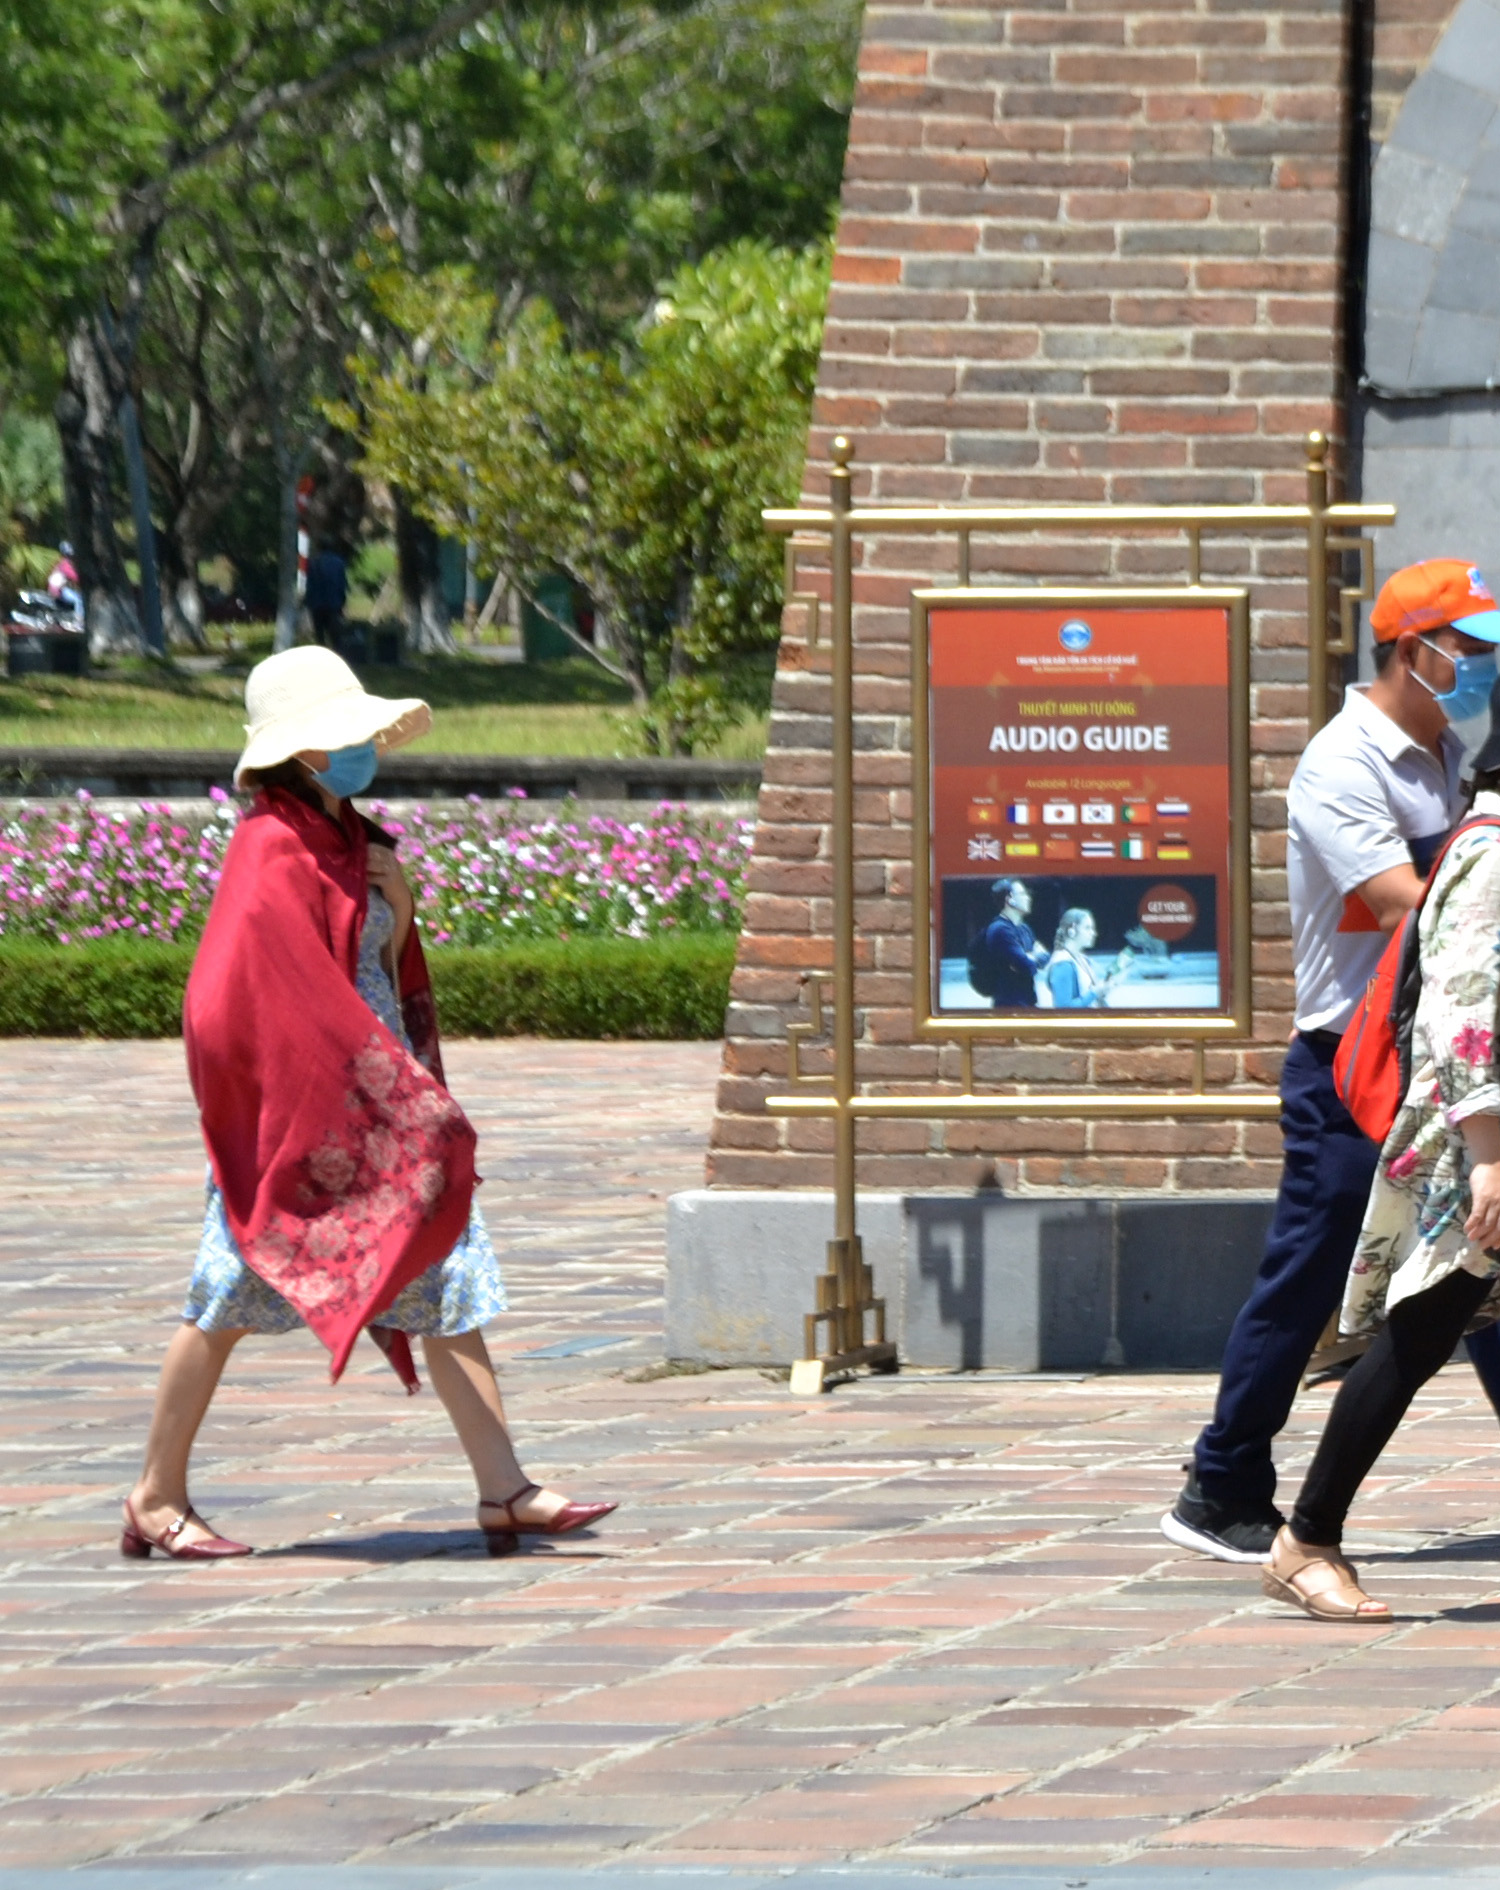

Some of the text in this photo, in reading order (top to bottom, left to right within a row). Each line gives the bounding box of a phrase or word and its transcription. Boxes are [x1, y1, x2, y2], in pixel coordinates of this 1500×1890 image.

[1059, 702, 1088, 717] MINH
[988, 725, 1170, 753] AUDIO GUIDE
